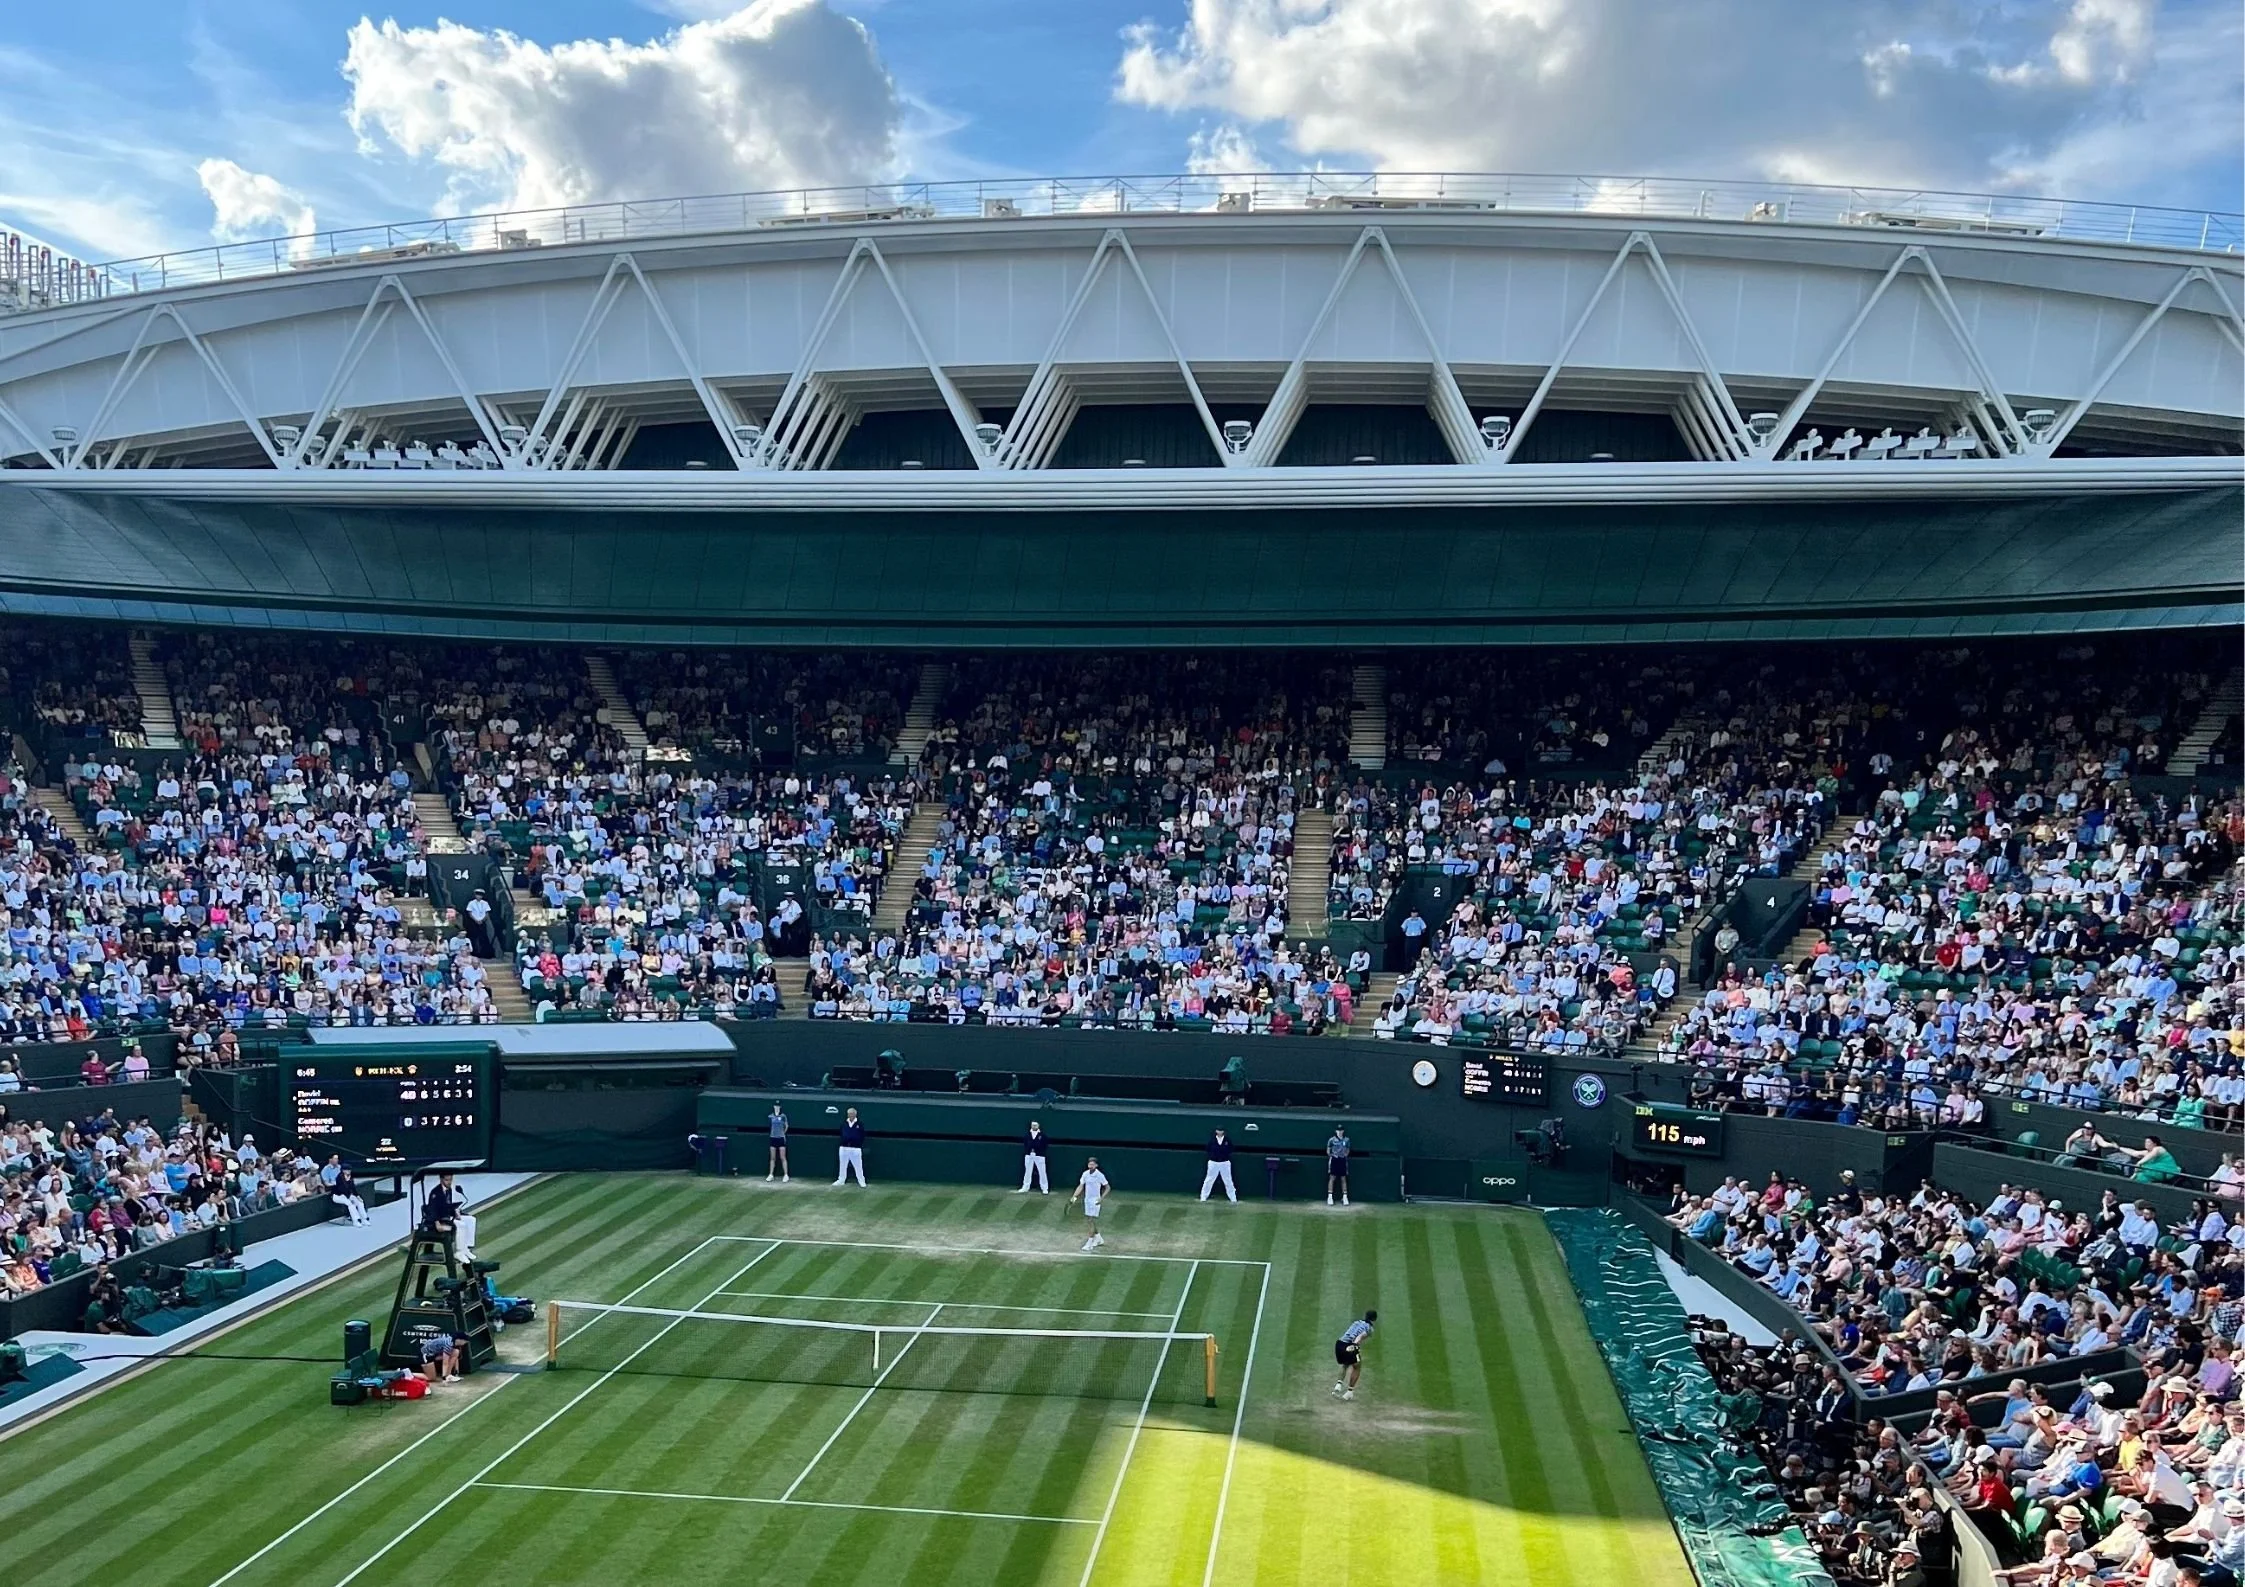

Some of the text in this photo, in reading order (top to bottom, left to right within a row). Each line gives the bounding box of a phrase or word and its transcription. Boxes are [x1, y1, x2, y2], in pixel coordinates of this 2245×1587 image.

[393, 714, 404, 724] 41
[764, 725, 778, 735] 43
[1916, 730, 1925, 741] 3
[454, 869, 470, 880] 34
[776, 874, 790, 884] 36
[1433, 886, 1441, 897] 2
[1766, 896, 1775, 908] 4
[420, 1090, 429, 1099] 6
[432, 1090, 439, 1099] 5
[443, 1089, 451, 1099] 6
[455, 1089, 462, 1098] 3
[466, 1089, 473, 1098] 1
[1635, 1105, 1654, 1116] IBM
[403, 1114, 473, 1127] 0 3 7 2 6 1
[1648, 1122, 1706, 1146] 115 mph
[1482, 1176, 1516, 1186] oppo
